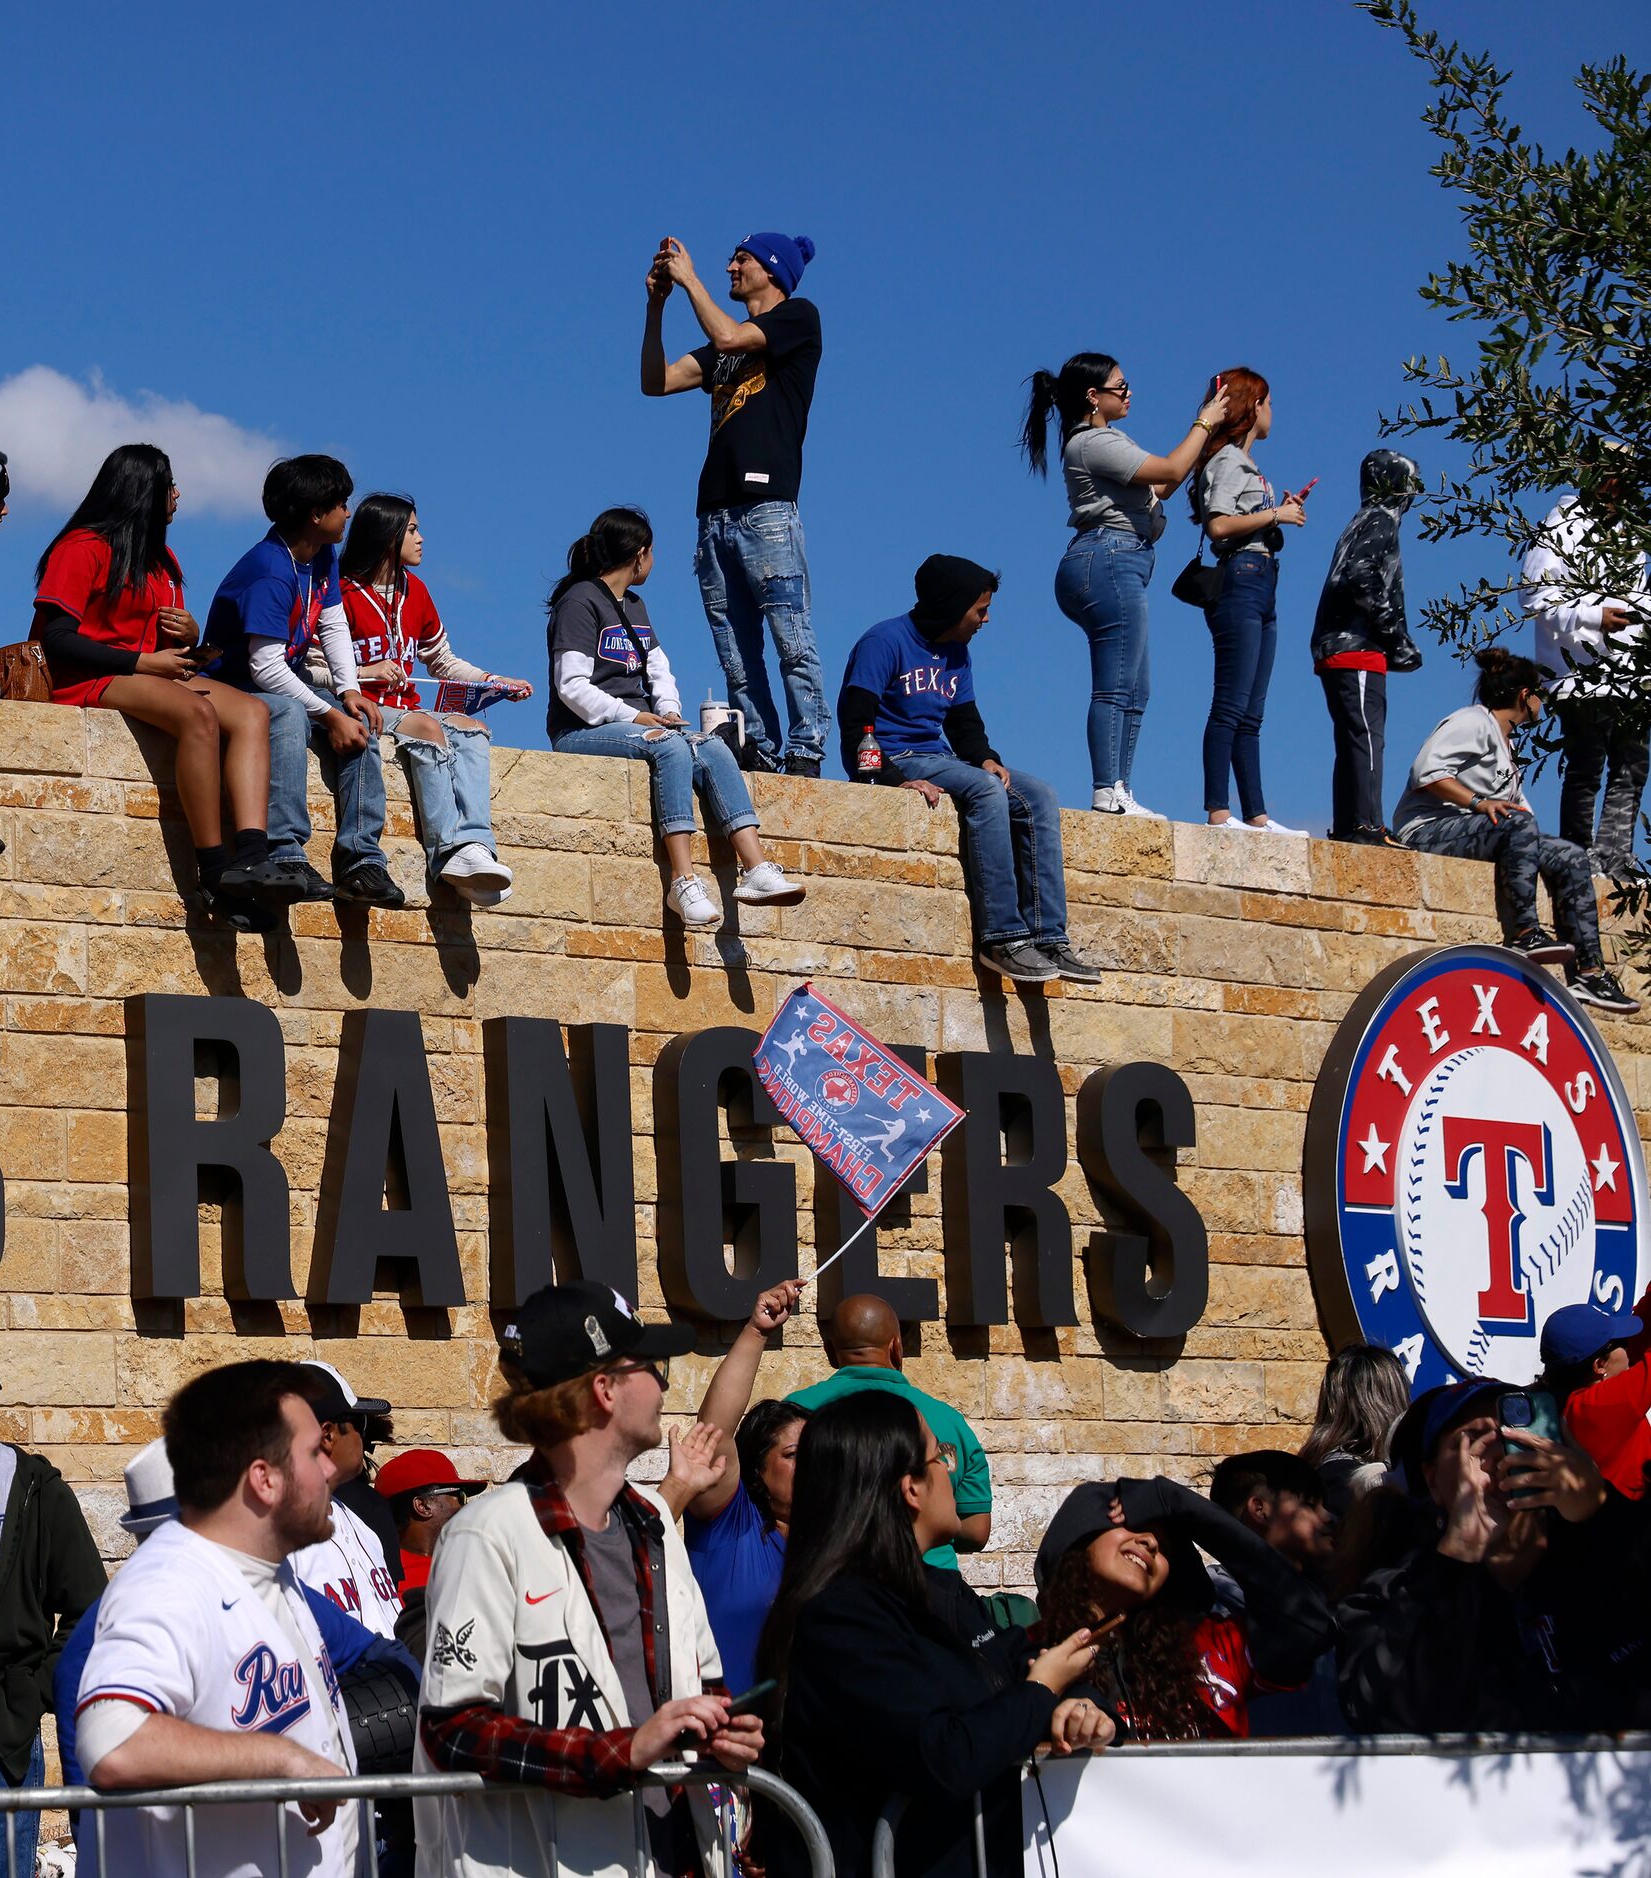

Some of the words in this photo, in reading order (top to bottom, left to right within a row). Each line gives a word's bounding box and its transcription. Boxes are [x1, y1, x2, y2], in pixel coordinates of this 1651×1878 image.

[353, 635, 418, 665] TEXA
[1376, 983, 1597, 1115] TEXAS
[1443, 1116, 1555, 1337] T
